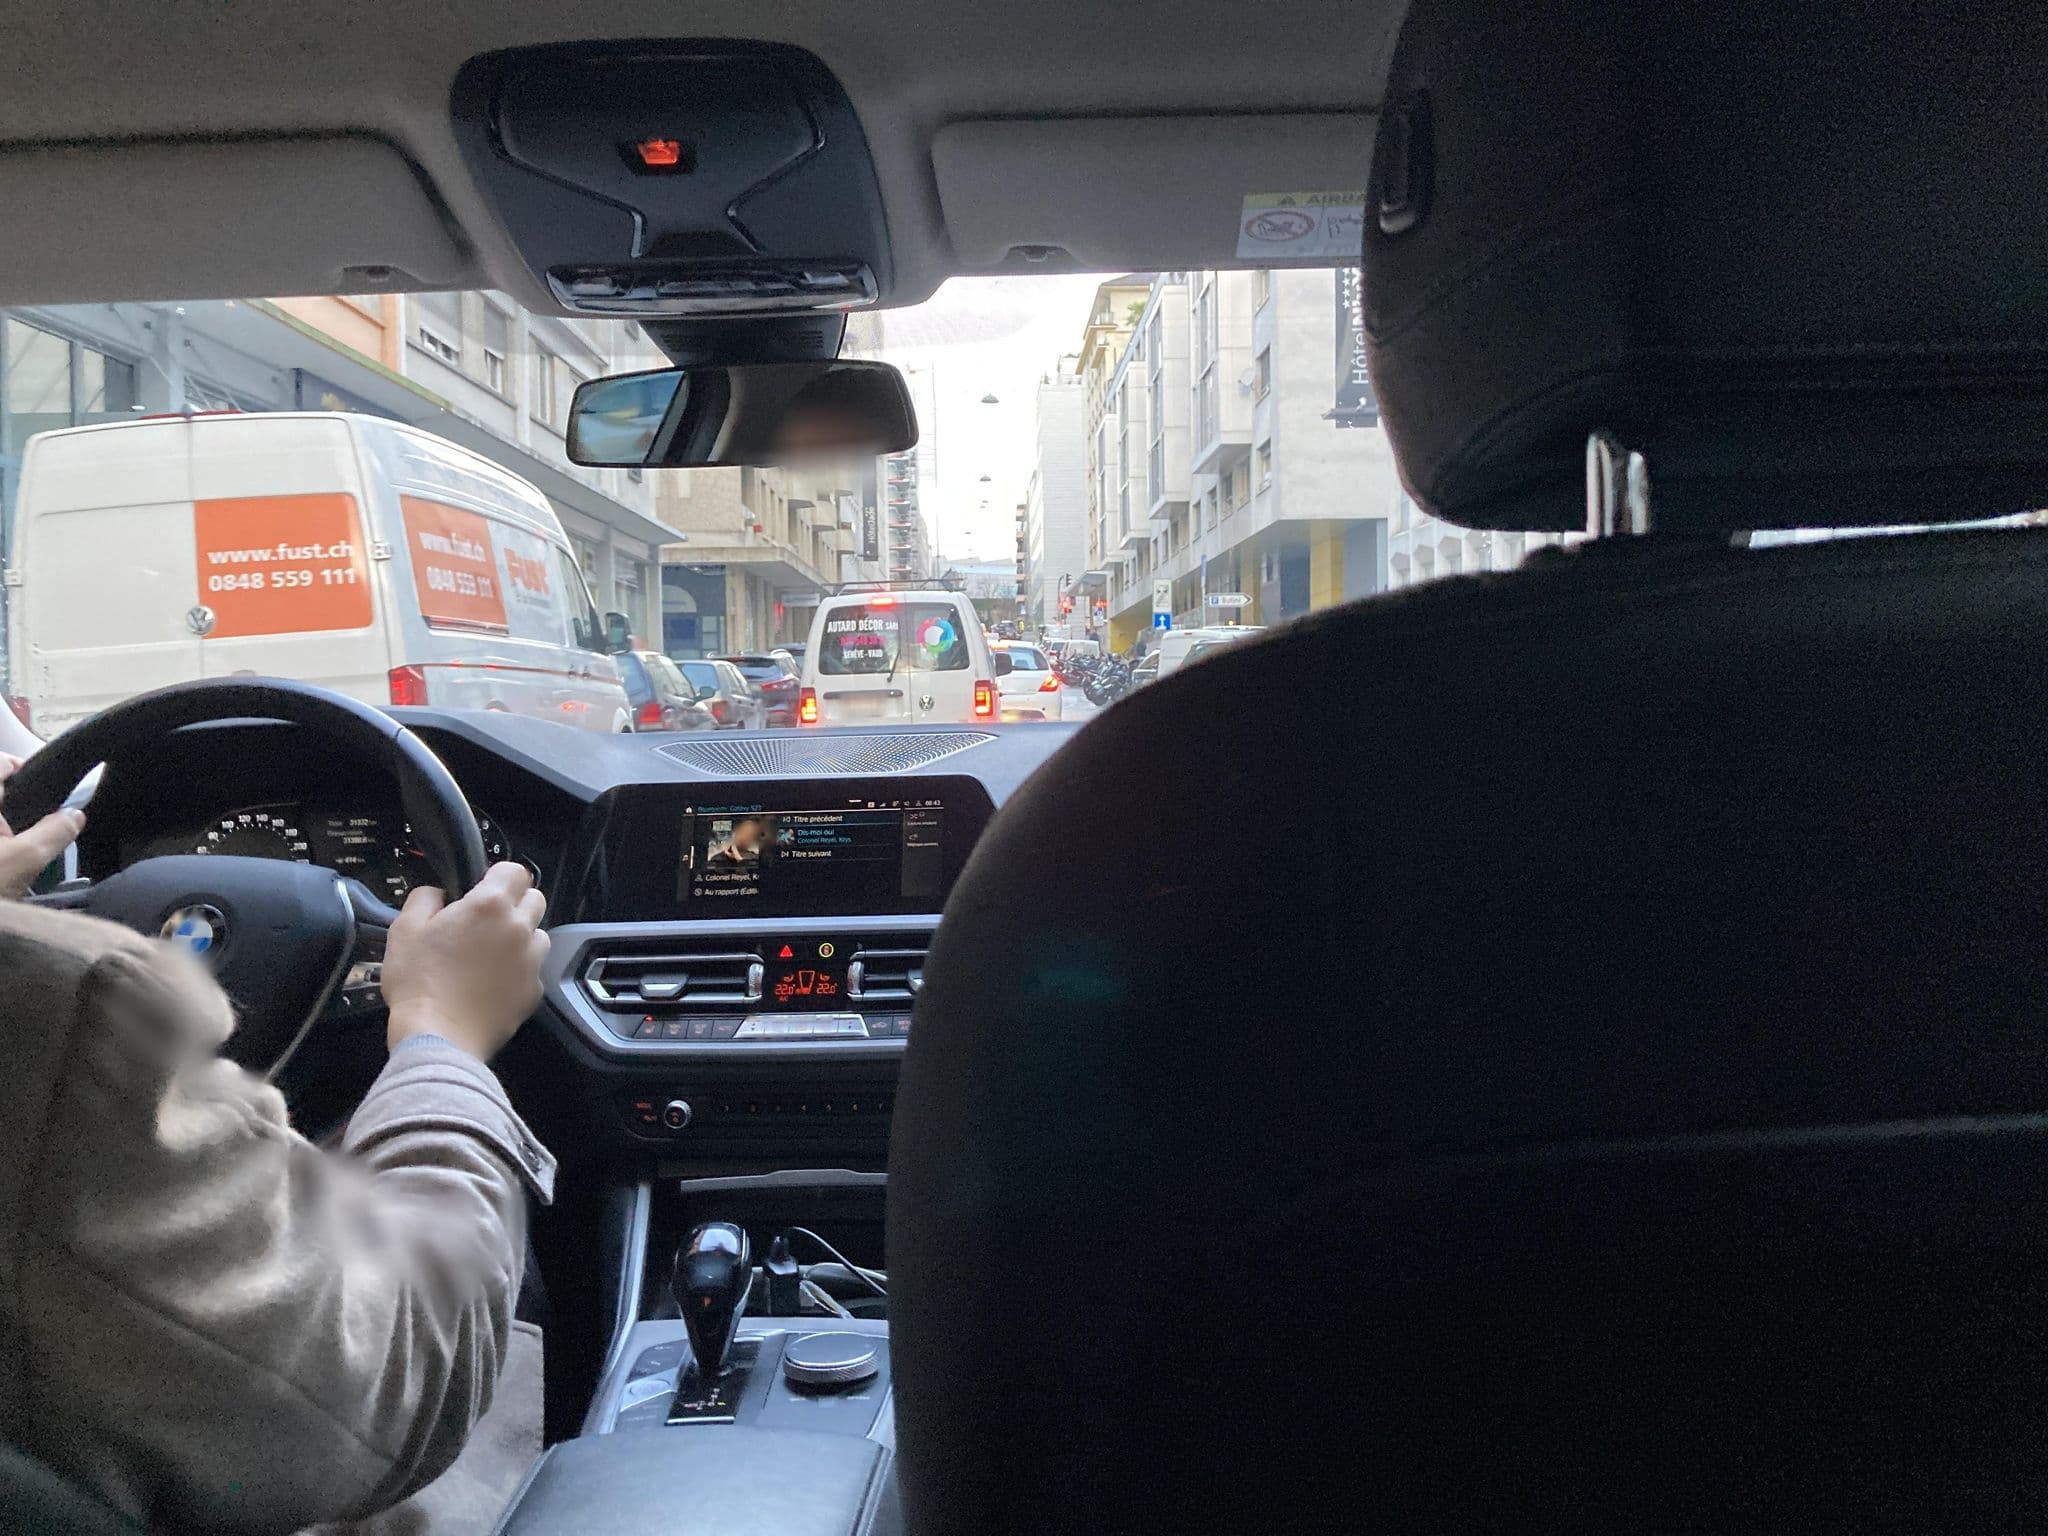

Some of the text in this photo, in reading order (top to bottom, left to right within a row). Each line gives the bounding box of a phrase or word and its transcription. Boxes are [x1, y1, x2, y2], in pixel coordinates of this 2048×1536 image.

[207, 540, 354, 564] www.fust.ch
[208, 567, 356, 591] 0848 559 111
[827, 620, 857, 633] AUTARD
[859, 618, 883, 631] DÉCOR
[793, 815, 843, 824] Titre précédent
[405, 823, 412, 833] 2
[493, 844, 500, 854] 6
[792, 849, 832, 858] Titre suivant
[705, 874, 730, 882] Colonel
[715, 888, 739, 897] rapport
